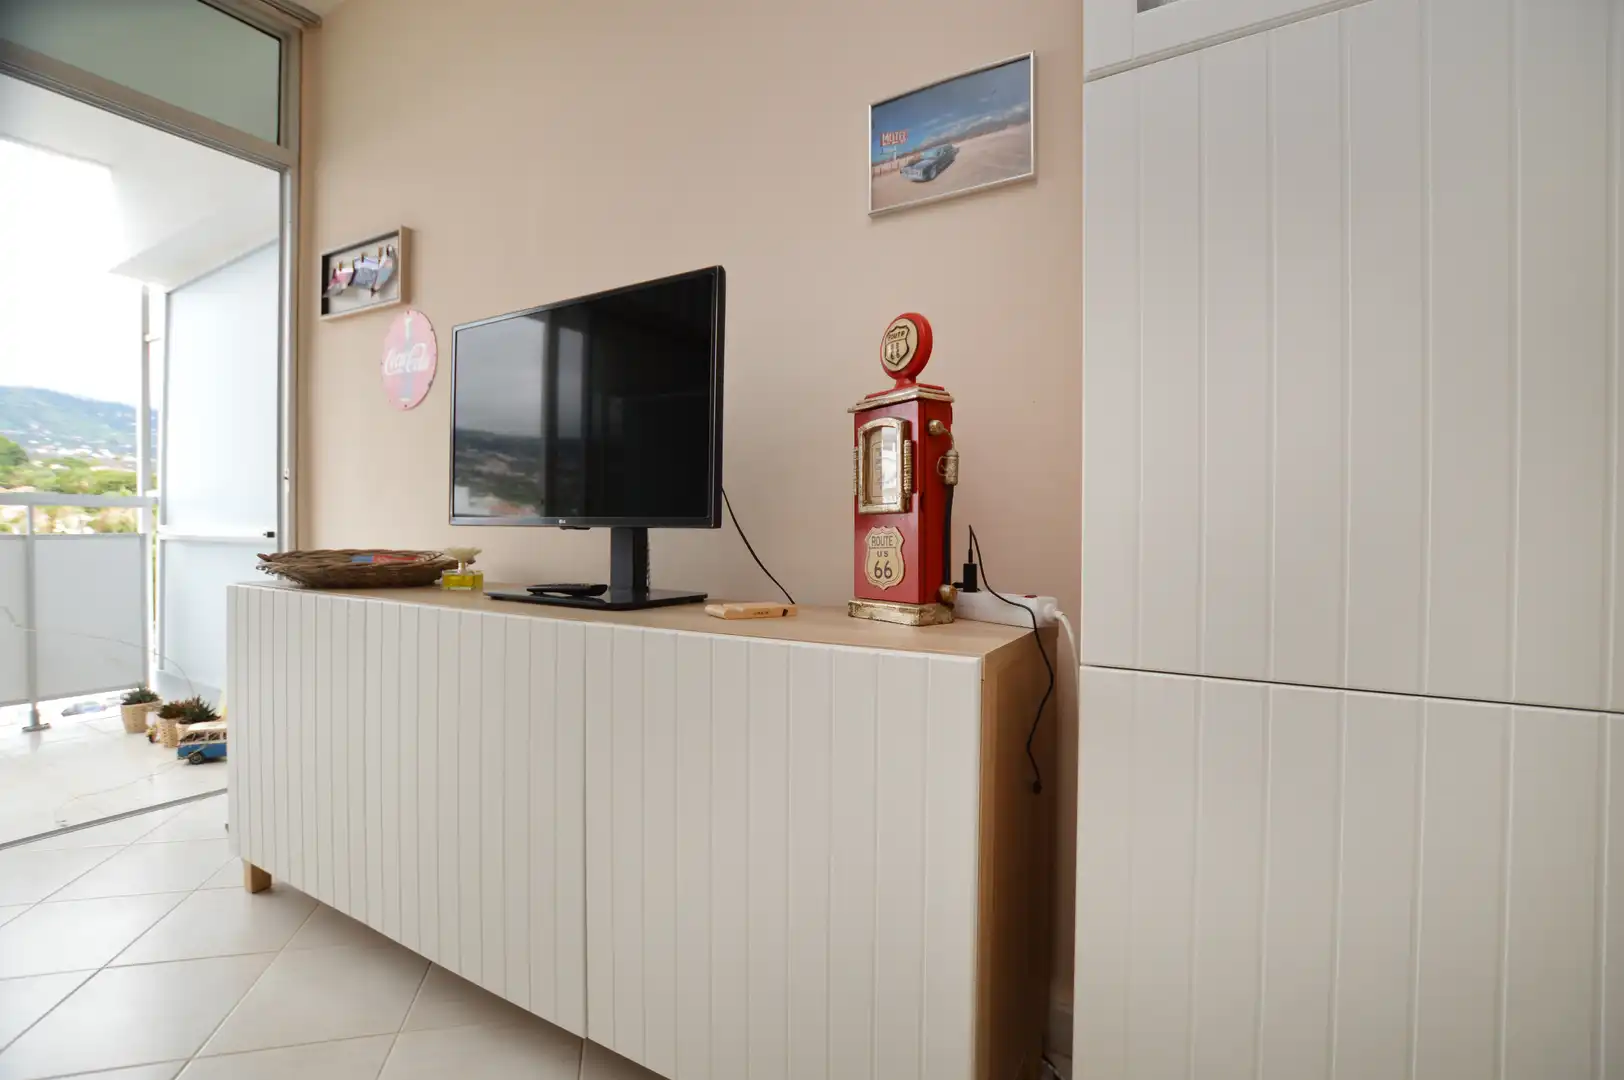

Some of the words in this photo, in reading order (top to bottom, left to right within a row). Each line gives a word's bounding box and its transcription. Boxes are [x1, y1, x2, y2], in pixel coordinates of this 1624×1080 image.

[871, 535, 894, 547] ROUTE
[876, 550, 889, 558] US
[874, 560, 893, 579] 66
